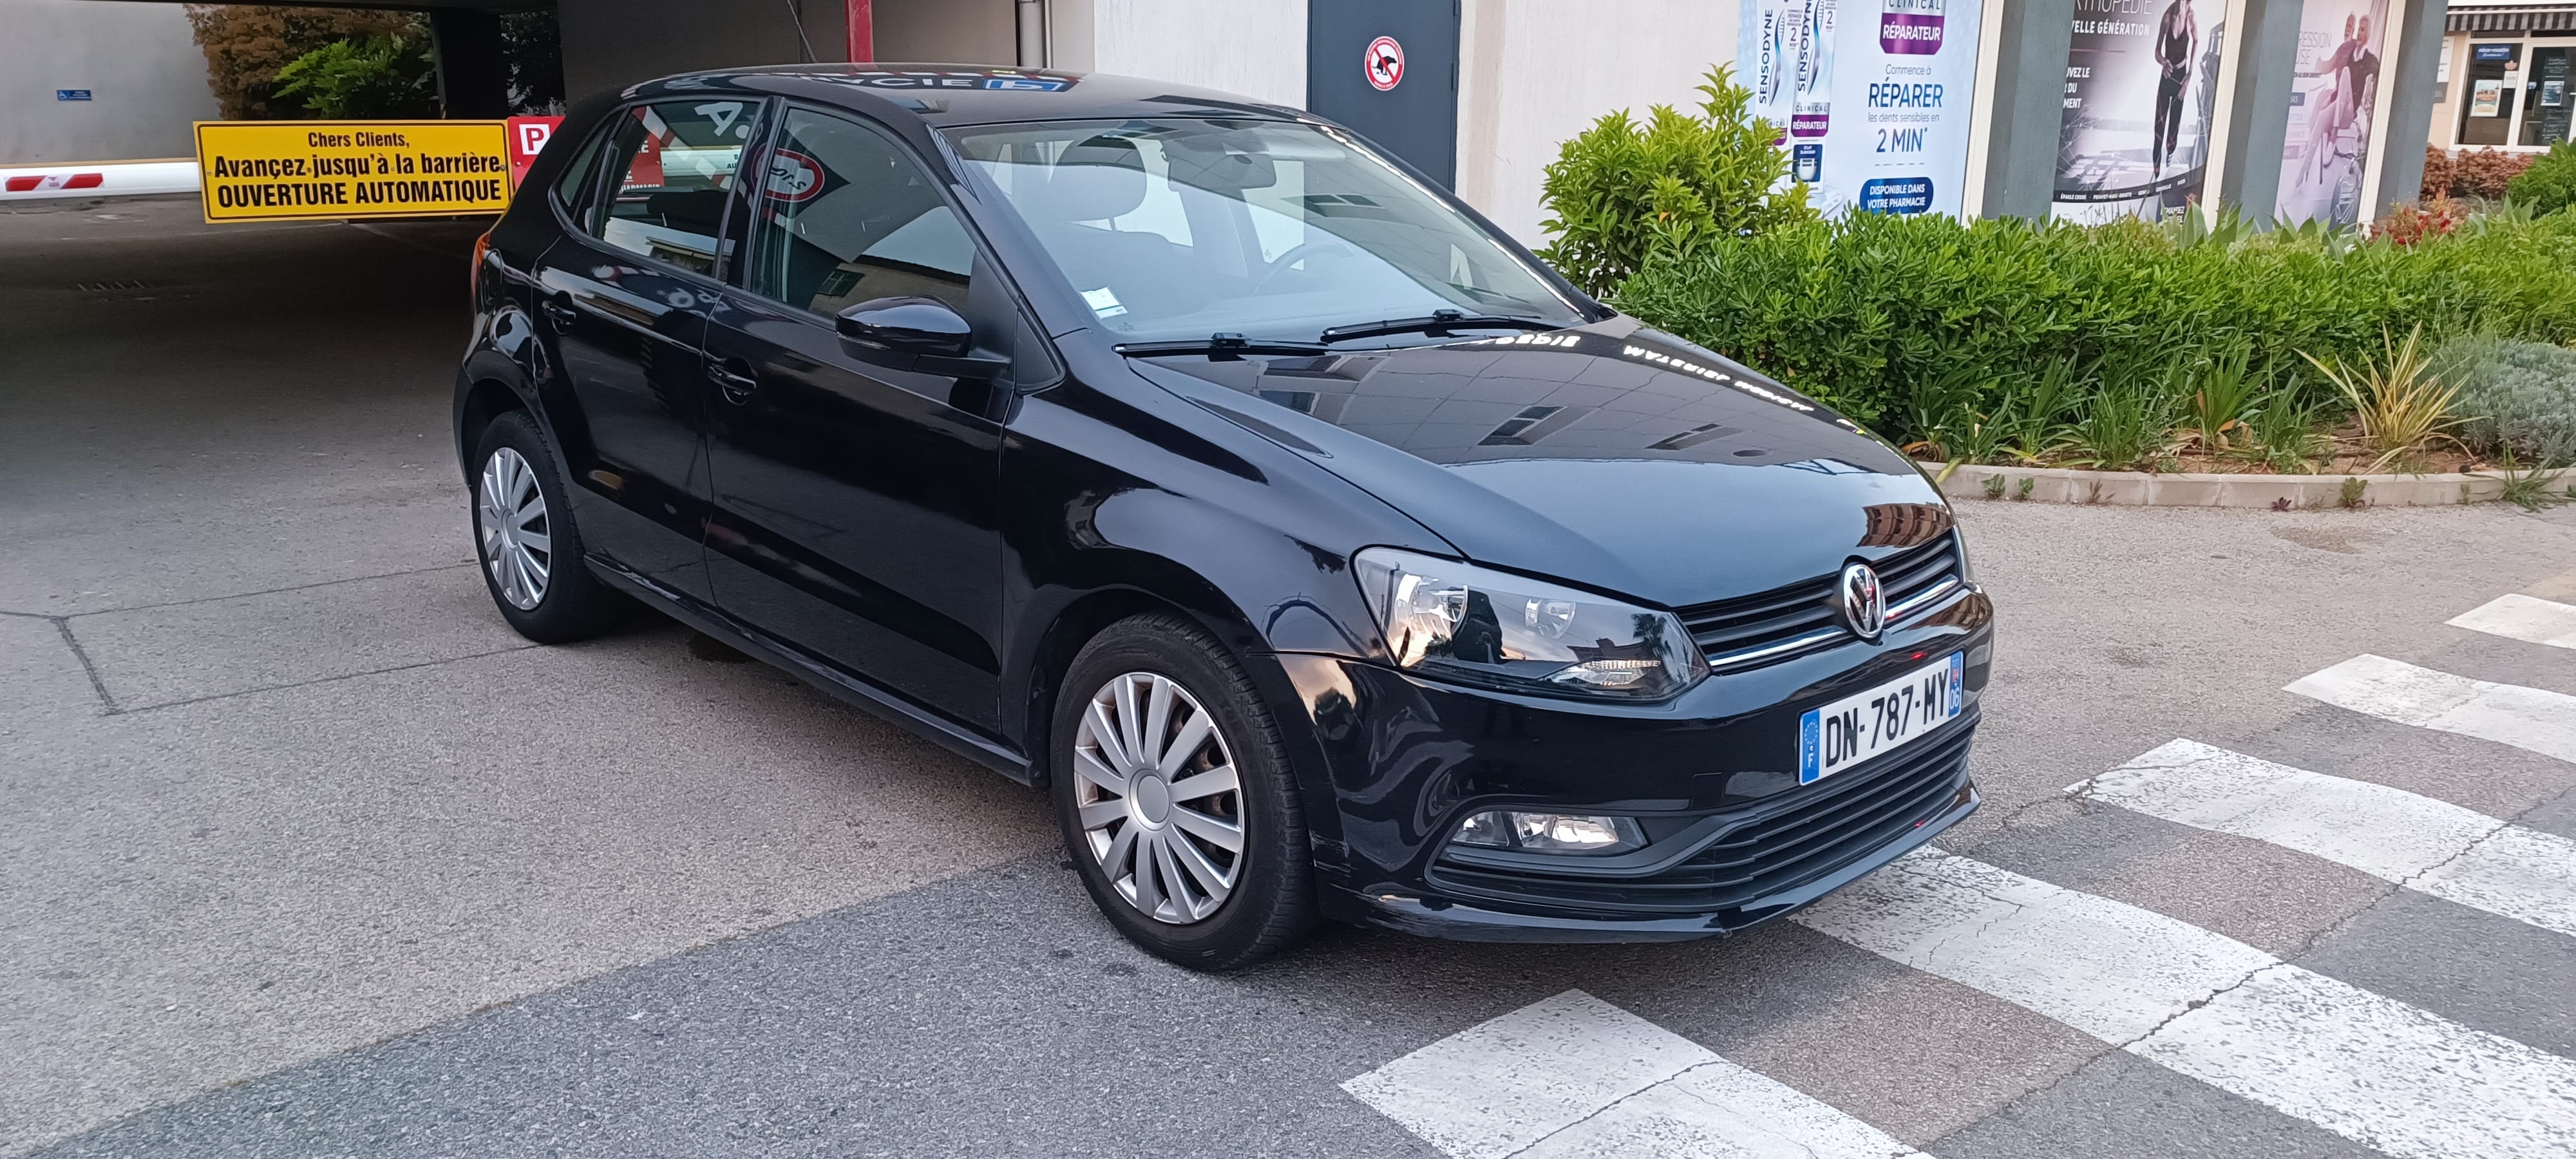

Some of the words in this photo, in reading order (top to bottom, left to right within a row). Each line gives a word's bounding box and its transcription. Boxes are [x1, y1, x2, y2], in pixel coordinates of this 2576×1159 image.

[1889, 0, 1940, 10] CLINICAL
[1790, 27, 1797, 42] 2
[1882, 21, 1941, 41] RÉPARATEUR
[2098, 19, 2150, 35] GÉNÉRATION
[1797, 0, 1812, 91] SENSODYN
[1759, 9, 1773, 104] SENSODYNE
[1886, 64, 1925, 75] Commence
[2082, 67, 2090, 78] LE
[1868, 77, 1944, 108] RÉPARER
[2068, 82, 2077, 93] DU
[1792, 119, 1827, 130] RÉPARATEUR
[1868, 112, 1877, 122] les
[1879, 113, 1899, 122] dents
[1900, 113, 1929, 122] sensibles
[1931, 113, 1940, 122] en
[308, 131, 351, 147] Chers
[355, 131, 410, 148] Clients,
[526, 127, 545, 151] P
[1876, 128, 1887, 153] 2
[214, 155, 307, 179] Avançez
[312, 153, 389, 178] jusqu'à
[395, 153, 414, 174] la
[421, 151, 500, 174] barrière
[218, 182, 348, 208] OUVERTURE
[355, 179, 502, 203] AUTOMATIQUE
[1870, 184, 1906, 195] DISPONIBLE
[1908, 184, 1925, 194] DANS
[1868, 198, 1888, 209] VOTRE
[1889, 197, 1926, 207] PHARMACIE
[1949, 686, 1960, 710] 06
[1826, 668, 1948, 768] DN-787-MY
[1808, 753, 1814, 768] F
